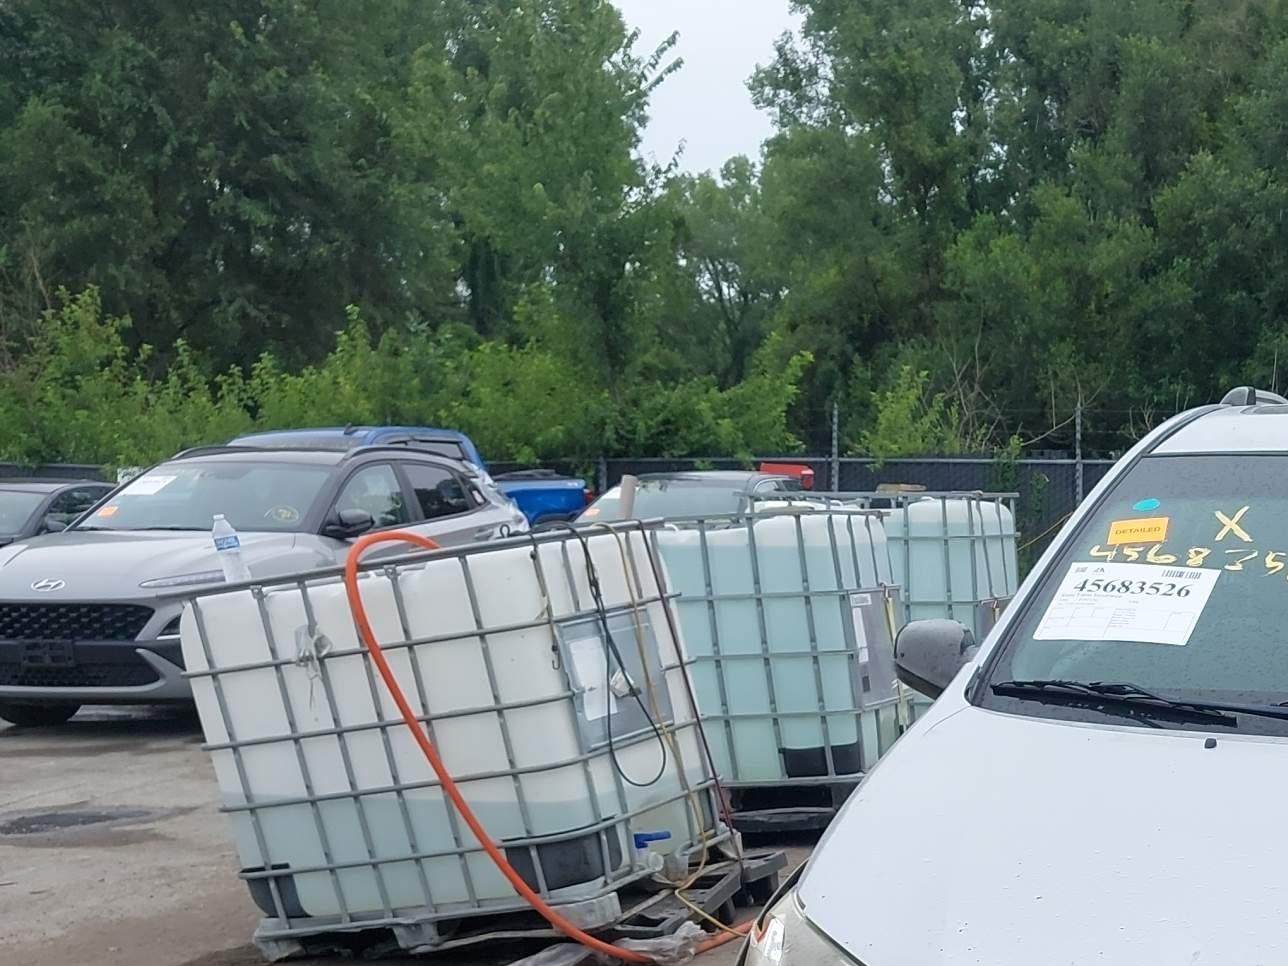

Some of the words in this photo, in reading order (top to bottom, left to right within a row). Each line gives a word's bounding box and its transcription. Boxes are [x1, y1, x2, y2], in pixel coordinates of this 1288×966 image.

[1115, 526, 1161, 534] DETAILED
[1215, 506, 1253, 542] X
[1073, 578, 1193, 598] 45683526
